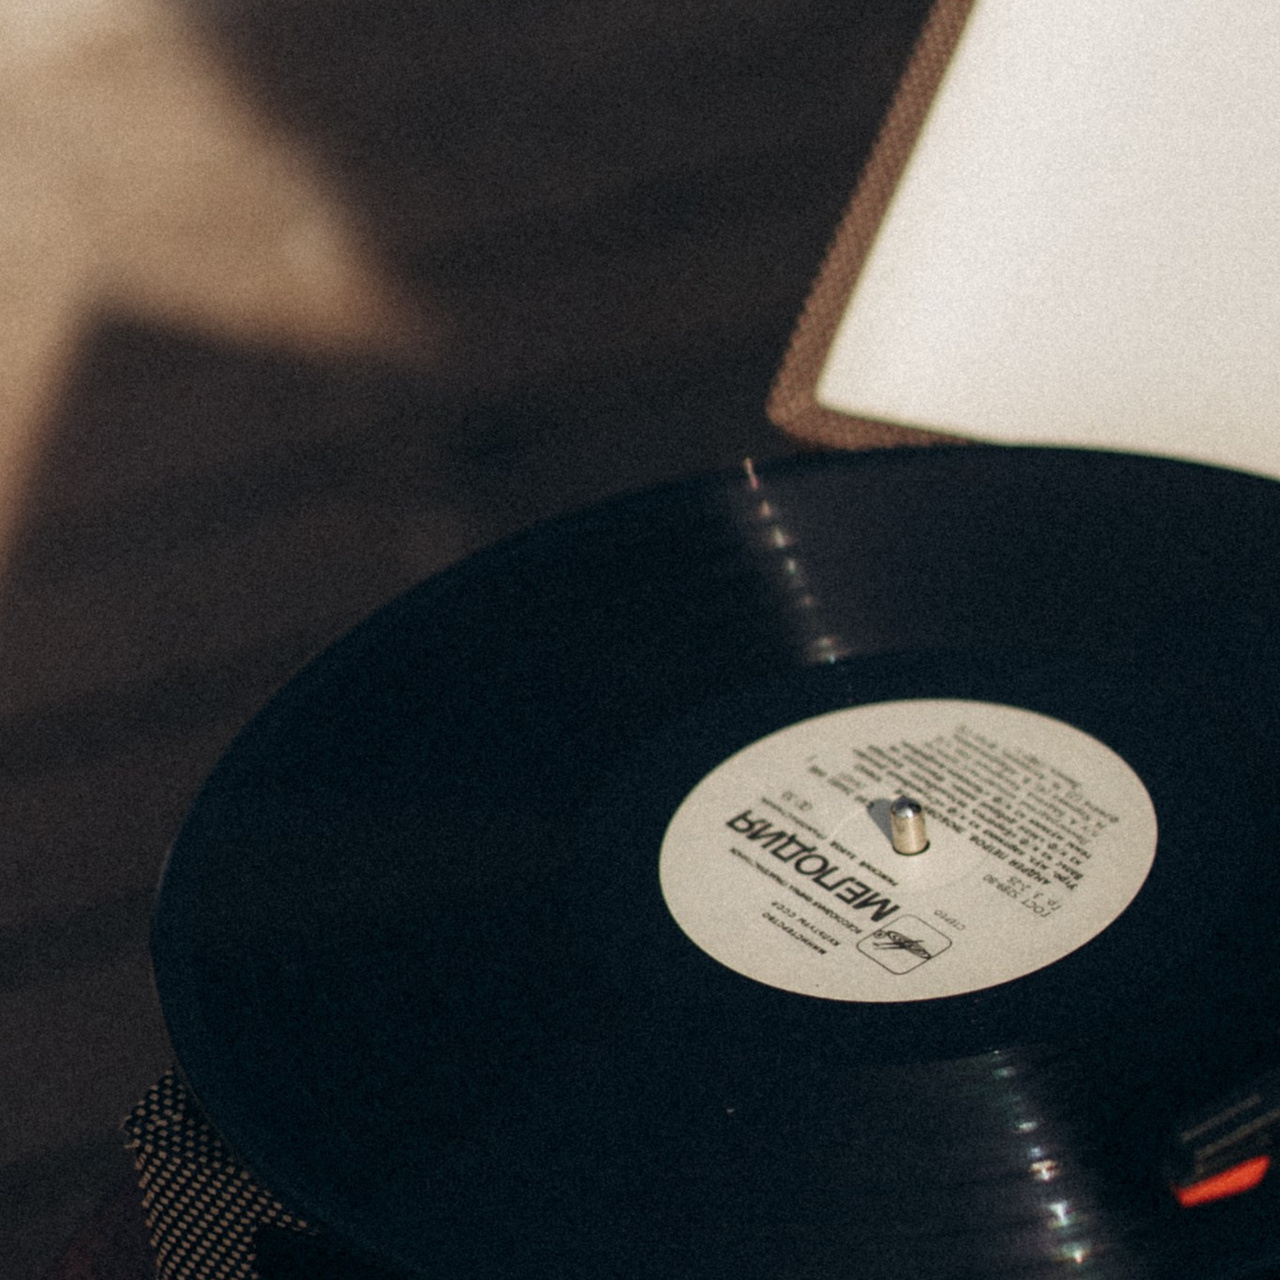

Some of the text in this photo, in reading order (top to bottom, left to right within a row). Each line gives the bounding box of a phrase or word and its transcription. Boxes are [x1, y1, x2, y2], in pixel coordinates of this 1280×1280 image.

[725, 809, 900, 921] МЕЛОДИЯ
[770, 900, 840, 946] КУЛЬТУРЫ СССР
[933, 909, 966, 930] СТЕРЕО
[1019, 898, 1051, 917] ГОСТ
[761, 912, 827, 955] МИНИСТЕРСТВО
